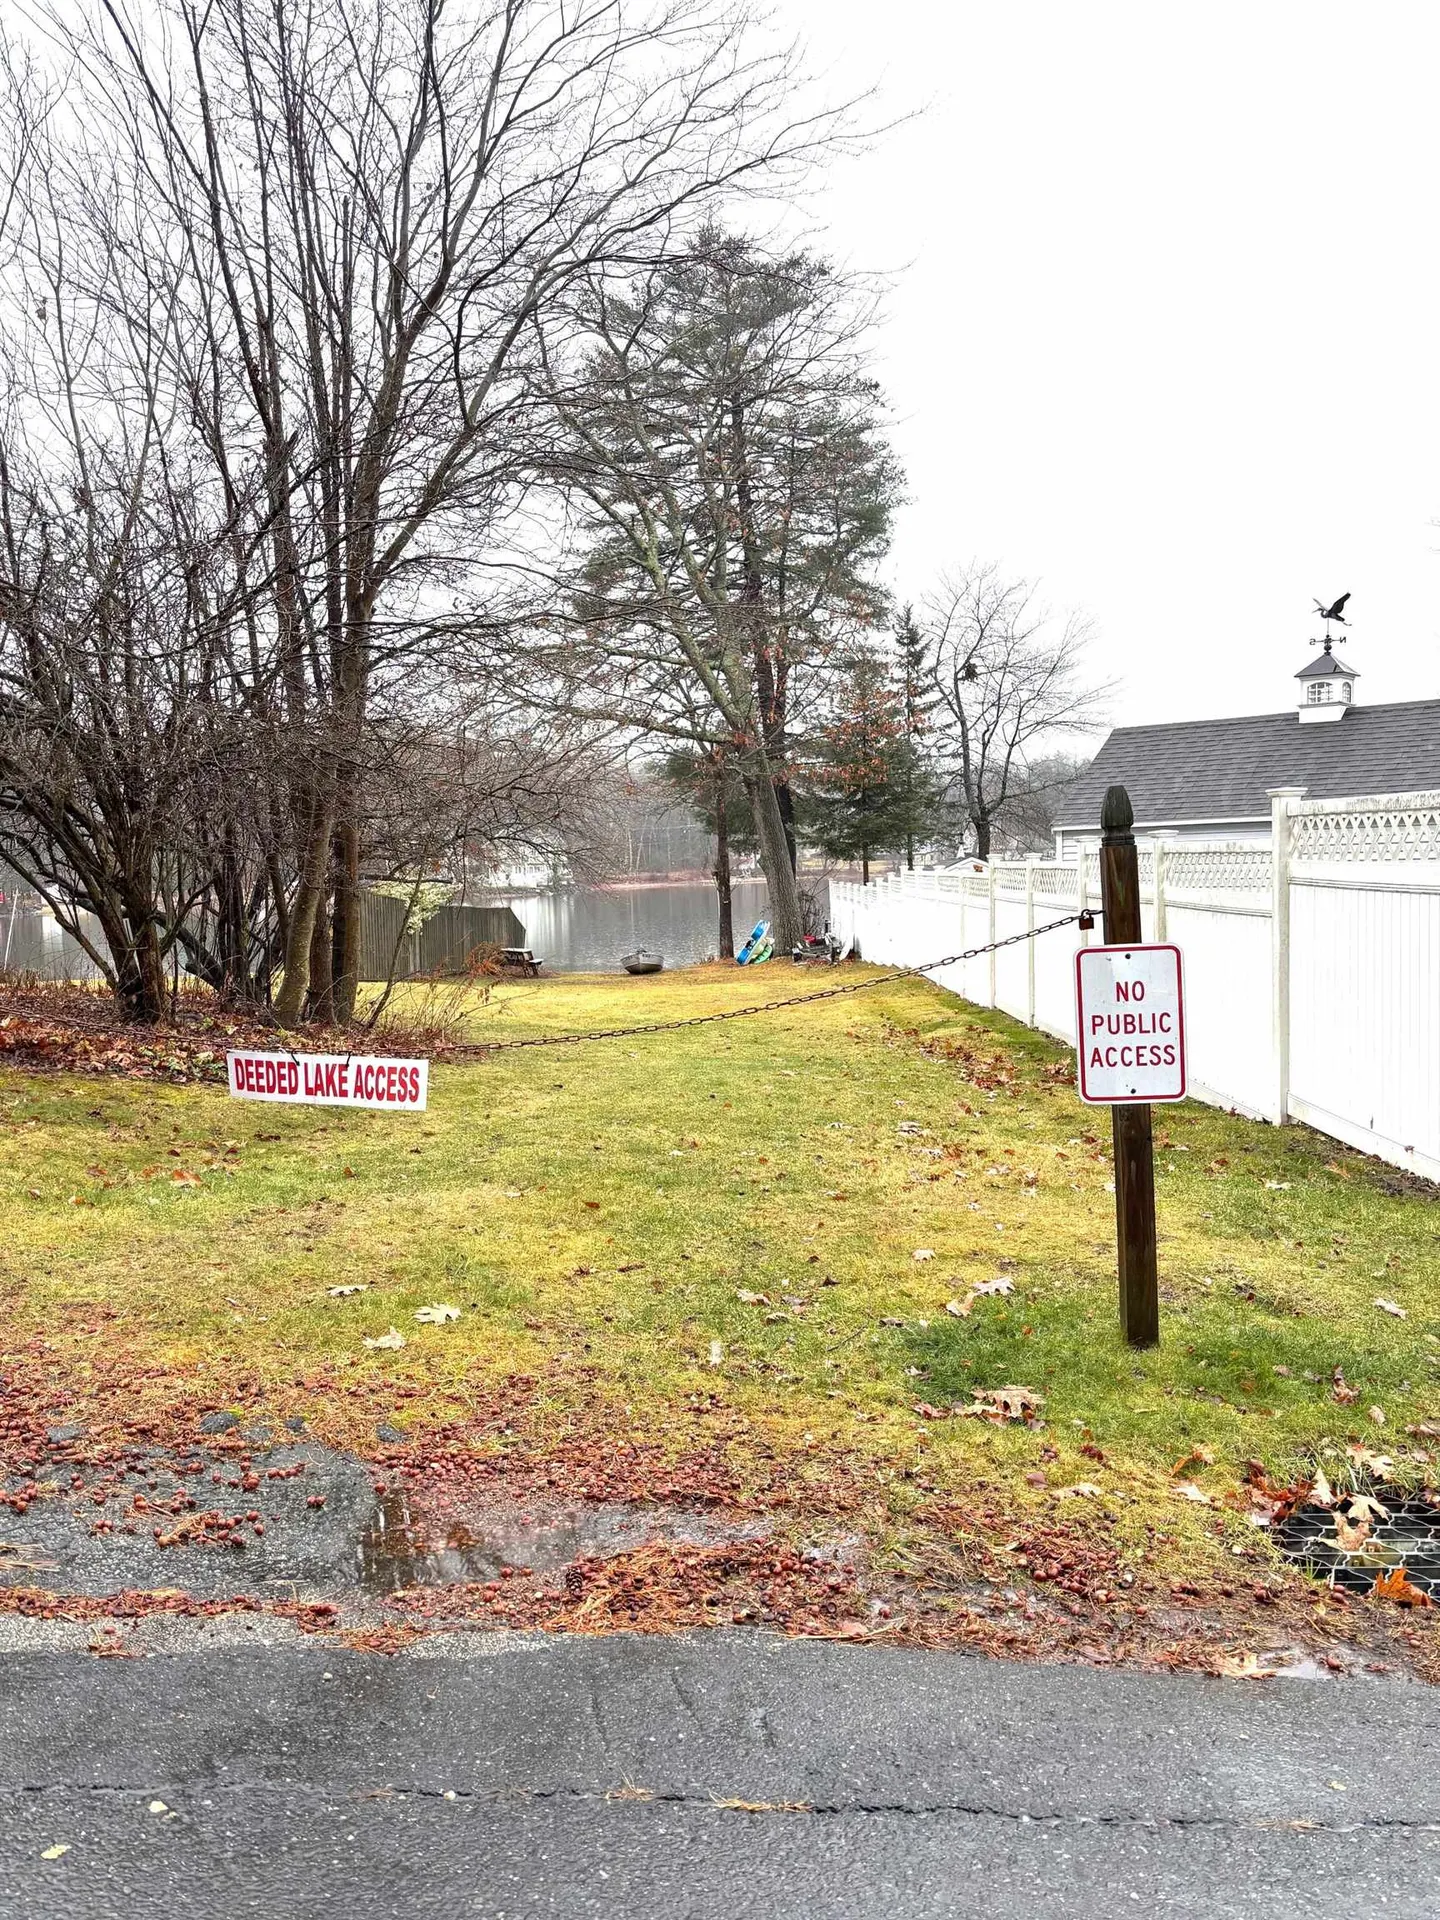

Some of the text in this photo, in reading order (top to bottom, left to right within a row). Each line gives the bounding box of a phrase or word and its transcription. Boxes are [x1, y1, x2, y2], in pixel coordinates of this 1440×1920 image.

[1115, 980, 1145, 1002] NO
[1091, 1012, 1172, 1035] PUBLIC
[1090, 1045, 1175, 1068] ACCESS
[233, 1057, 420, 1103] DEEDED LAKE ACCESS
